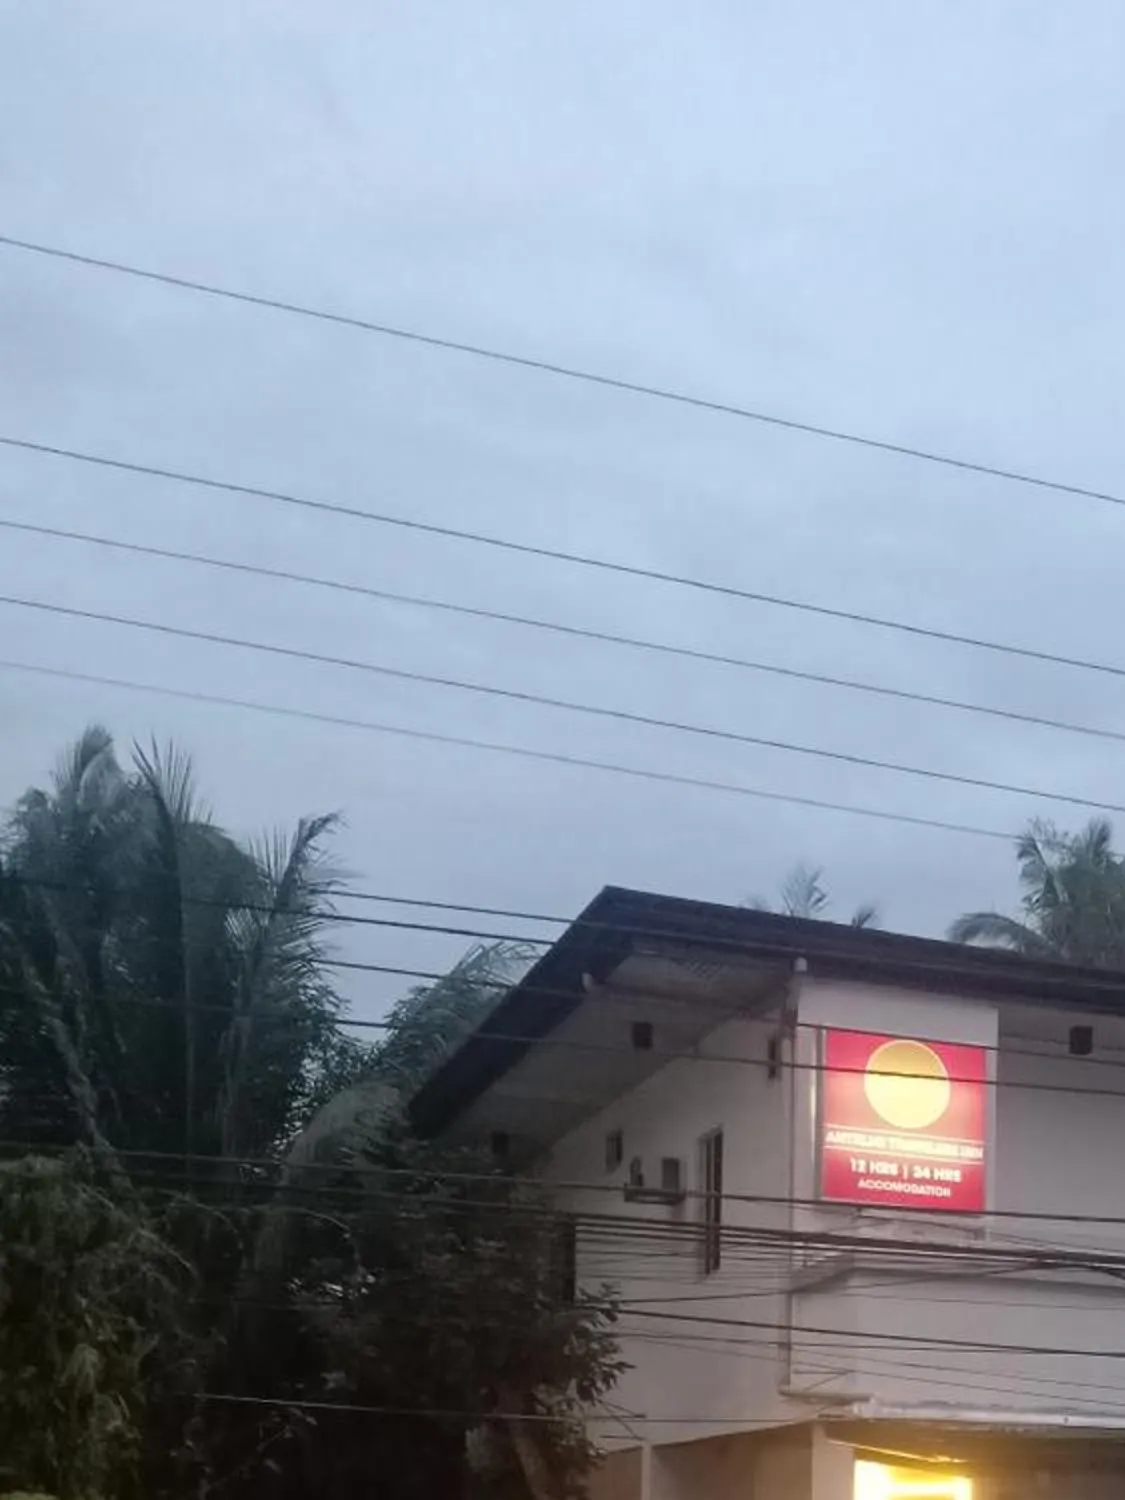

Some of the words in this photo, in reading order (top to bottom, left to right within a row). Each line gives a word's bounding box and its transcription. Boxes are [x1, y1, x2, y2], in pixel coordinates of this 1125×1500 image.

[850, 1157, 867, 1174] 12
[869, 1160, 898, 1176] HRS
[913, 1165, 931, 1180] 24
[934, 1167, 961, 1183] HRS
